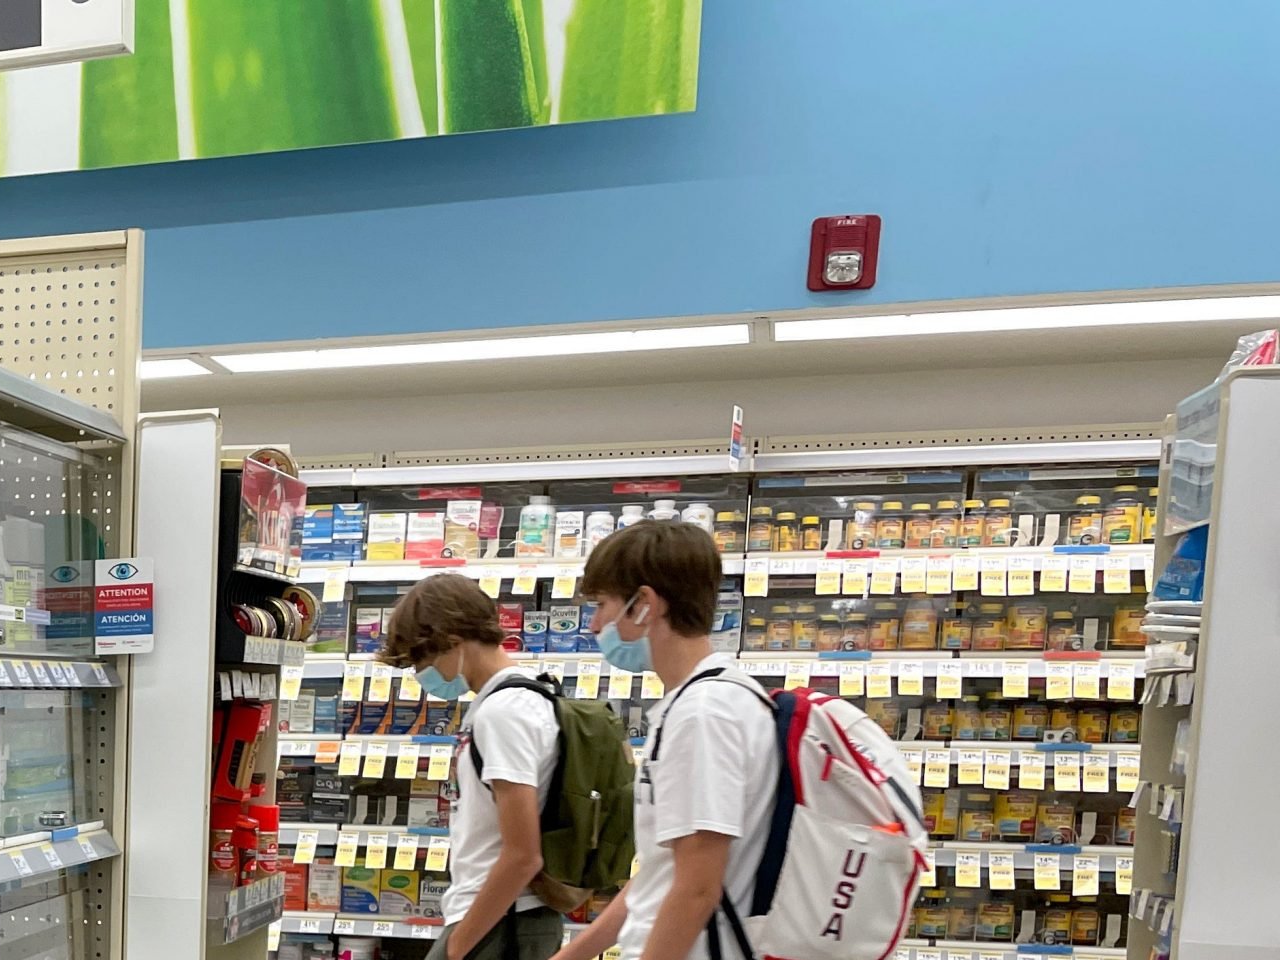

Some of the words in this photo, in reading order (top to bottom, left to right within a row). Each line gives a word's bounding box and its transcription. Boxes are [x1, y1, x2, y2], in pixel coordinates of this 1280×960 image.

[837, 218, 857, 227] FIRE
[98, 587, 148, 599] ATTENTION
[101, 612, 146, 624] ATENCIÓN
[821, 849, 867, 942] USA
